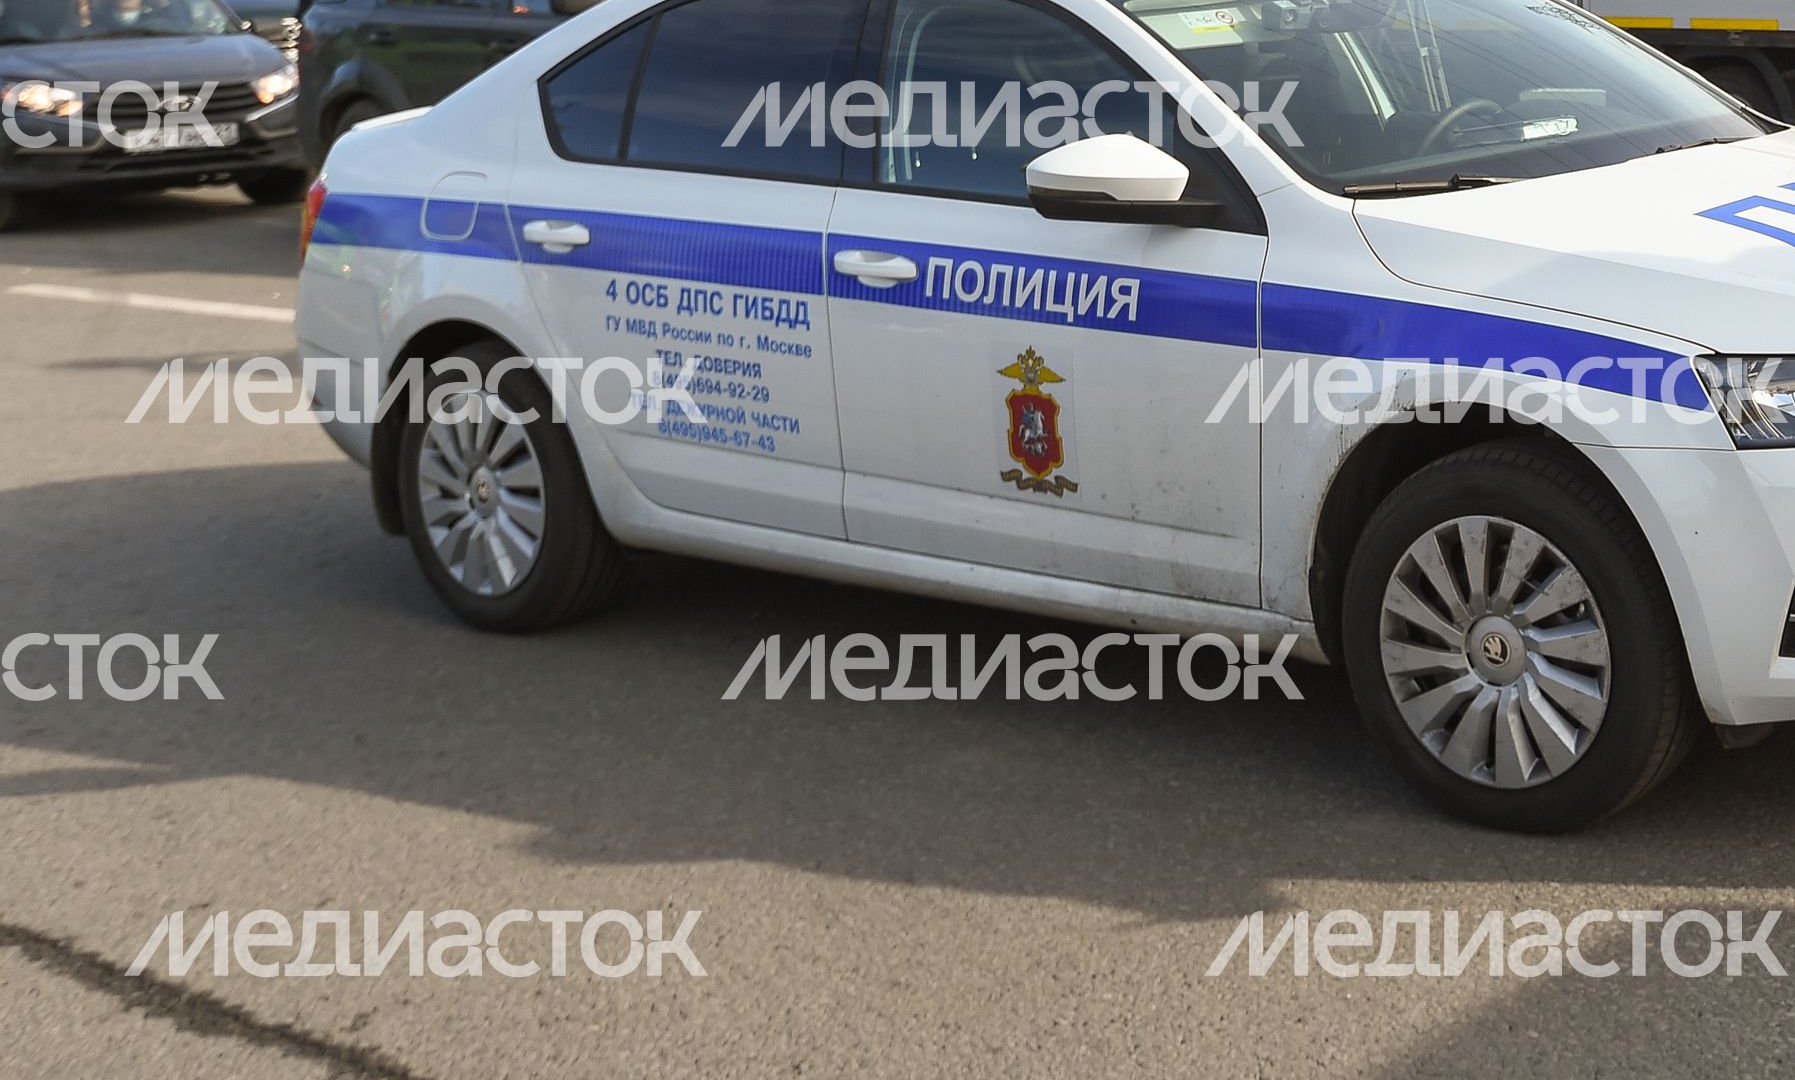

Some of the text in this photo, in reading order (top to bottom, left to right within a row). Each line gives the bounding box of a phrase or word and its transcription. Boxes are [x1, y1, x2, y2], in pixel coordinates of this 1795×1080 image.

[605, 279, 811, 331] 4 ОСБ ДПС ГИБДД
[925, 256, 1141, 322] ПОЛИЦИЯ
[606, 315, 813, 359] ГУ МВД России по г. Москве
[692, 354, 763, 379] ДОВЕРИЯ
[751, 411, 801, 434] ЧАСТИ
